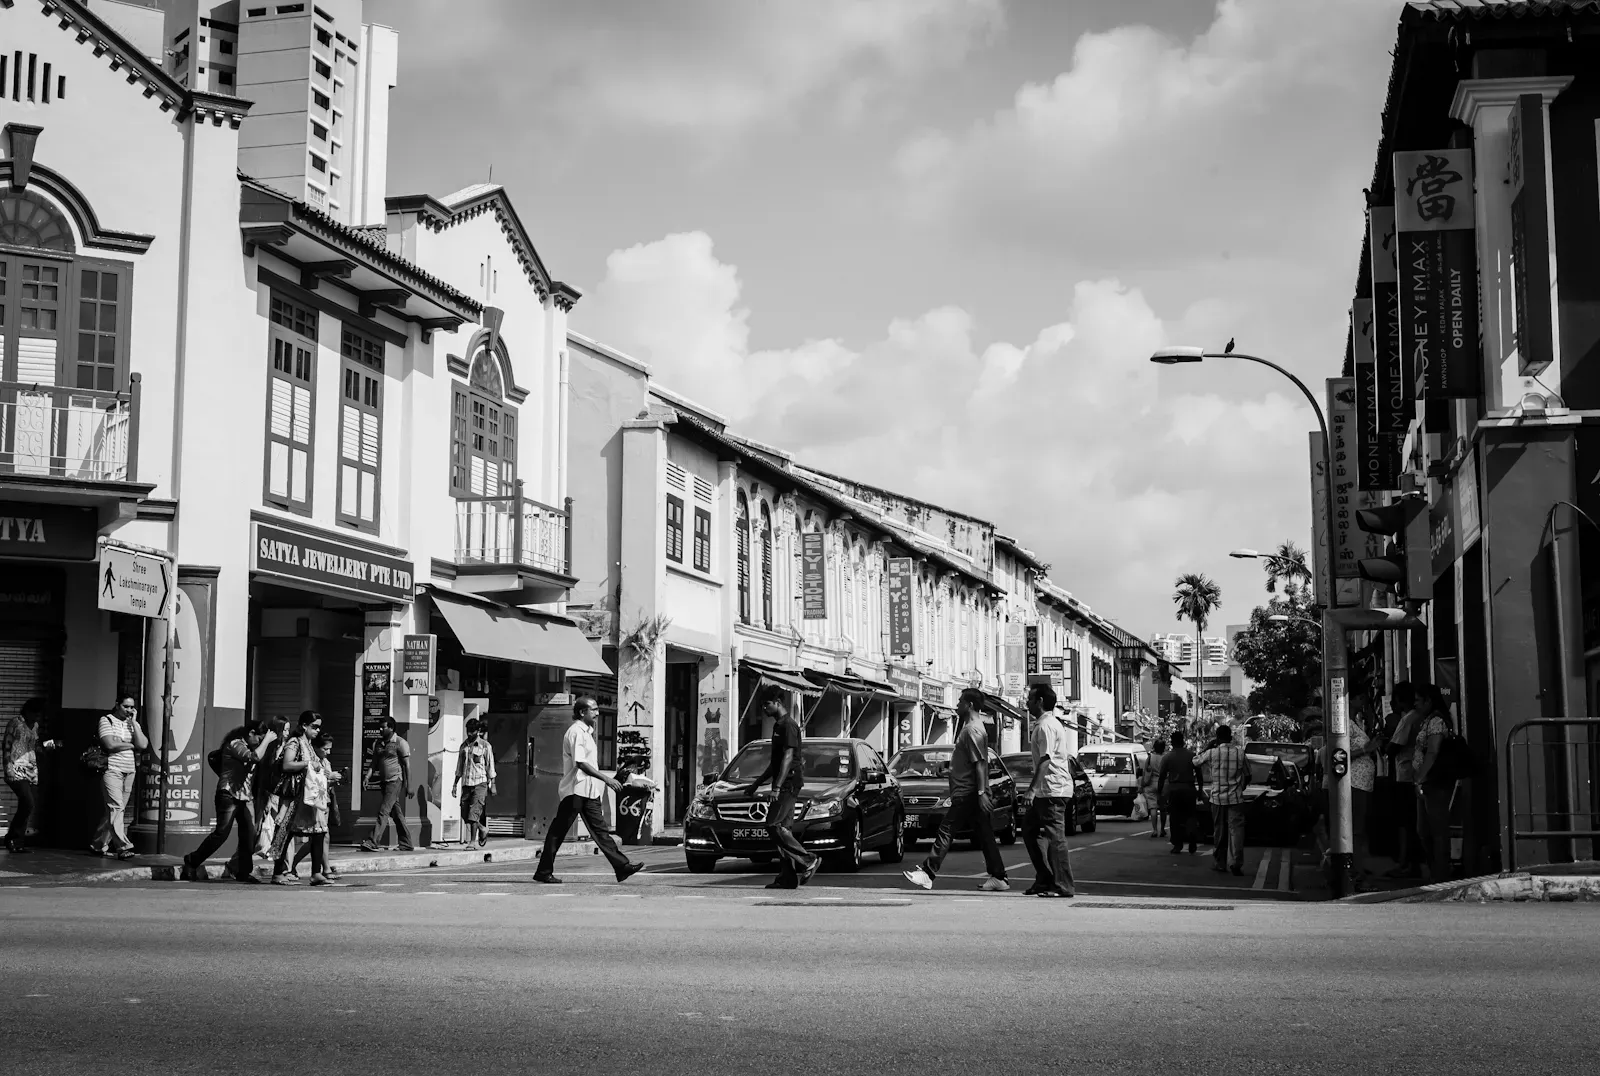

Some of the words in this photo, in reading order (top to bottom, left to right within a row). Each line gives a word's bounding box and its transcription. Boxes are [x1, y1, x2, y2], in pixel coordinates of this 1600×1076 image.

[1406, 155, 1463, 222] 當
[1412, 241, 1426, 290] MAX
[1438, 288, 1446, 310] PAJAK
[1450, 268, 1462, 307] DAILY
[1387, 291, 1399, 338] MAX
[1439, 312, 1447, 334] KEDAI
[1452, 311, 1464, 349] OPEN
[1440, 348, 1448, 389] PAWNSHOP
[1366, 370, 1376, 410] MAX
[1389, 350, 1404, 428] MONEY
[1368, 420, 1380, 486] MONEY
[260, 538, 300, 566] SATYA
[302, 548, 368, 581] JEWELLERY
[370, 563, 391, 586] PTE
[392, 569, 412, 590] LTD
[804, 534, 821, 570] SELVI
[132, 561, 147, 575] Shree
[889, 562, 902, 603] SKY
[119, 576, 158, 595] Lakshminarayan
[804, 573, 823, 609] STORE
[130, 595, 147, 609] Temple
[406, 640, 428, 650] NATHAN
[901, 642, 911, 653] 9
[1027, 641, 1037, 655] OM
[1027, 656, 1037, 673] SR
[415, 678, 428, 689] 79A
[900, 719, 912, 744] SK
[619, 795, 642, 817] 66
[733, 829, 750, 839] SKF
